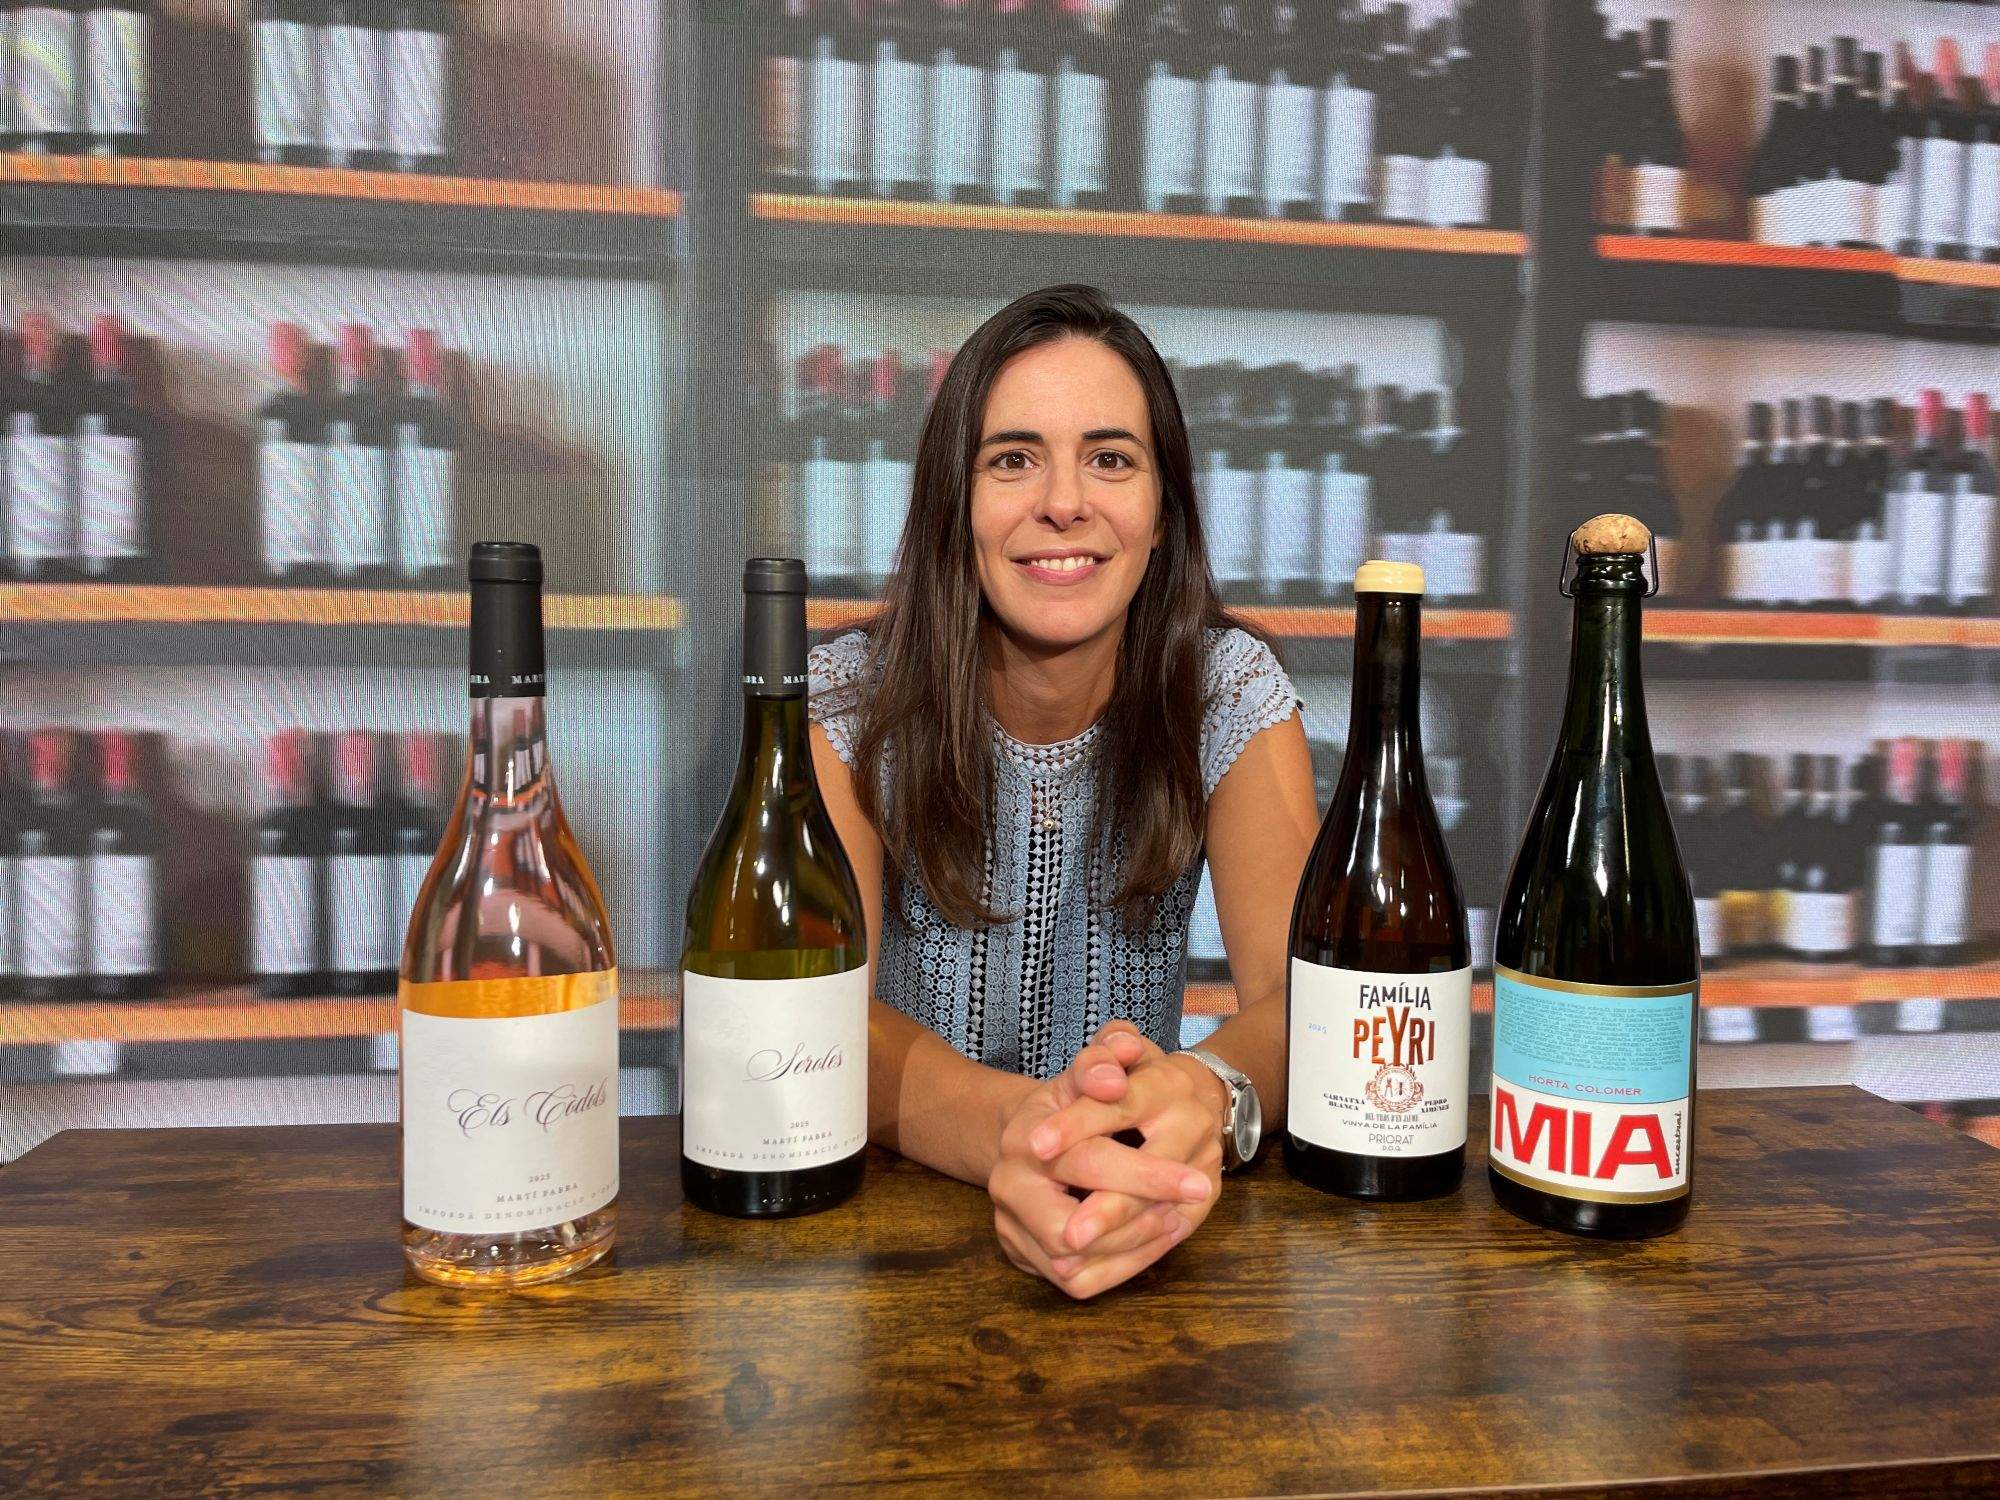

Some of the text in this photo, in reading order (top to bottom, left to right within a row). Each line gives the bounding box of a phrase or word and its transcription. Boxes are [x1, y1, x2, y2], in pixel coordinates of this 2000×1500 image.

[1359, 982, 1432, 1010] FAMÍLIA
[1353, 1006, 1436, 1066] PEYRI
[1528, 1074, 1643, 1096] HORTA COLOMER
[448, 1088, 517, 1139] Els
[1342, 1119, 1370, 1129] VINYA
[1402, 1121, 1438, 1130] FAMÍLIA
[1368, 1133, 1414, 1145] PRIORAT
[1494, 1086, 1674, 1180] MIA
